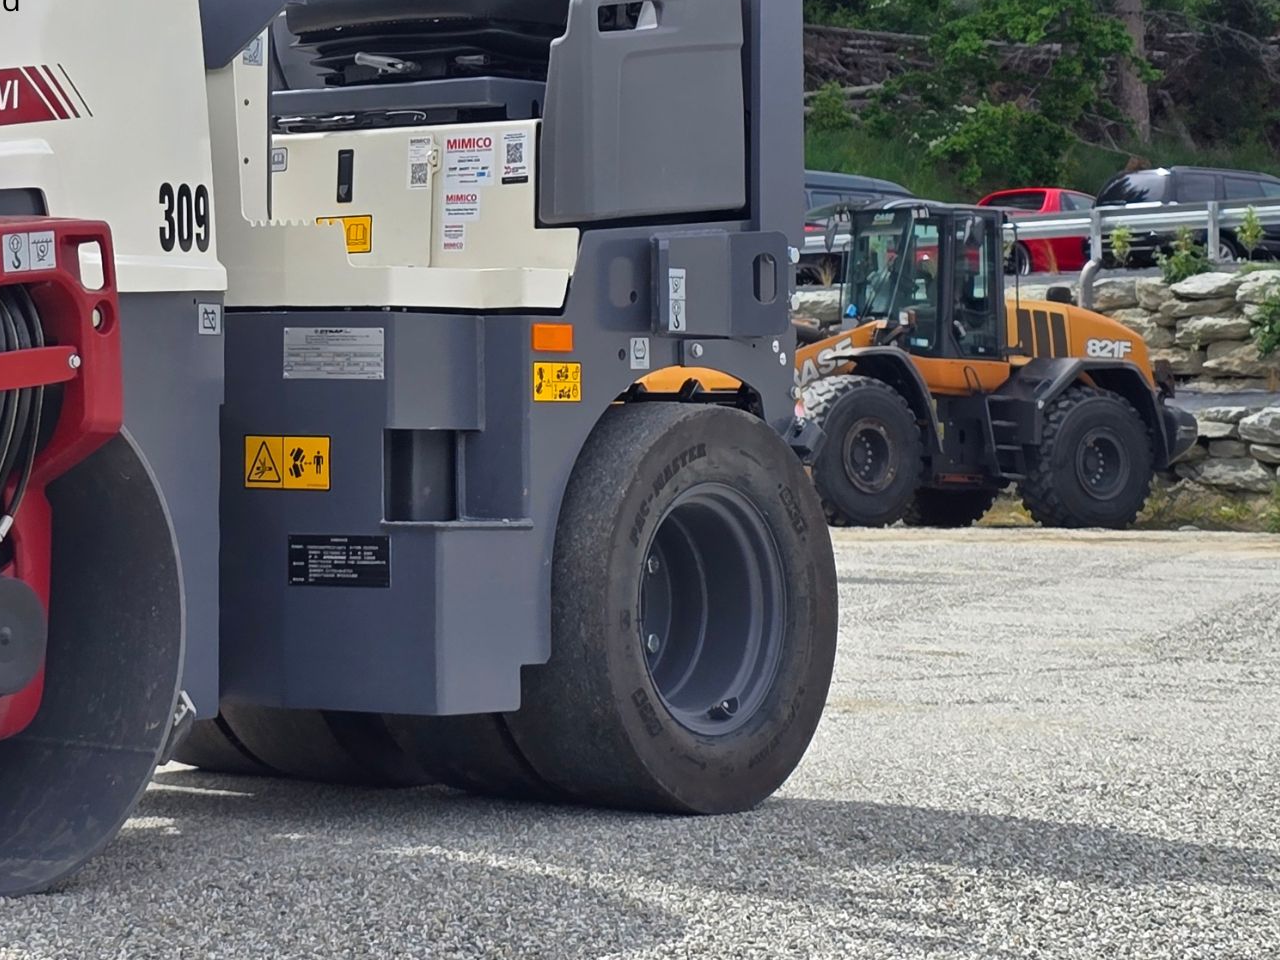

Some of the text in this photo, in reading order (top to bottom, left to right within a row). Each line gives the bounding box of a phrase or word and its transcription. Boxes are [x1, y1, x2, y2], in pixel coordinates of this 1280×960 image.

[446, 137, 492, 150] MIMICO
[446, 193, 477, 202] MIMICO
[159, 182, 210, 252] 309
[1087, 339, 1131, 358] 821F
